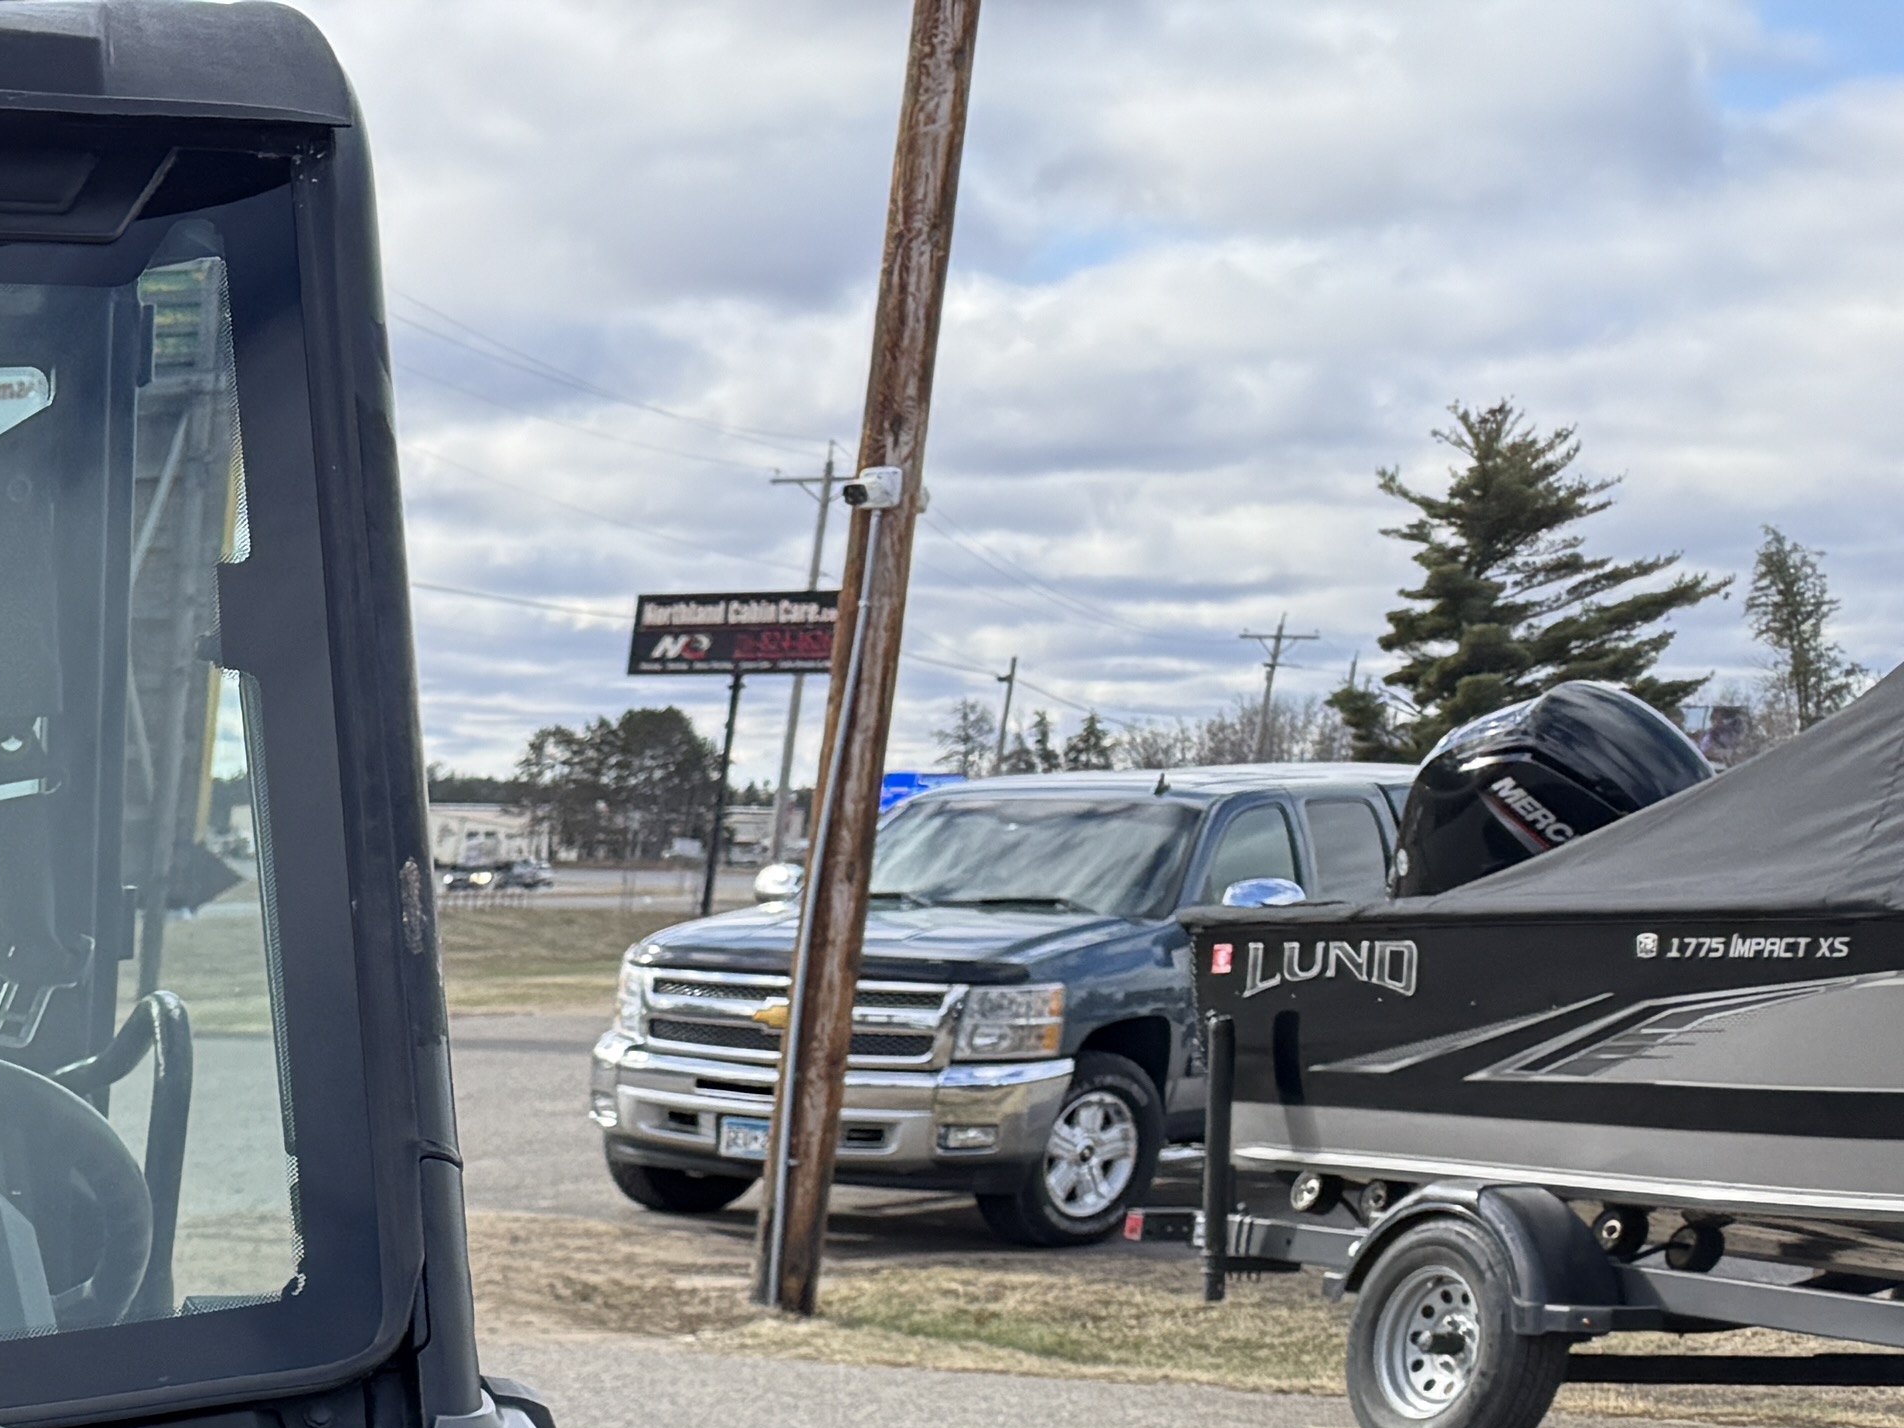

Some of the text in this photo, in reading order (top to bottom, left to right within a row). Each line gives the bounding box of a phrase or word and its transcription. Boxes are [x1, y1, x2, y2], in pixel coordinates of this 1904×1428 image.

[1491, 776, 1574, 842] MERC
[1242, 940, 1418, 999] LUND
[1666, 936, 1726, 958] 1775
[1728, 932, 1812, 958] IMPACT
[1815, 936, 1851, 958] XS
